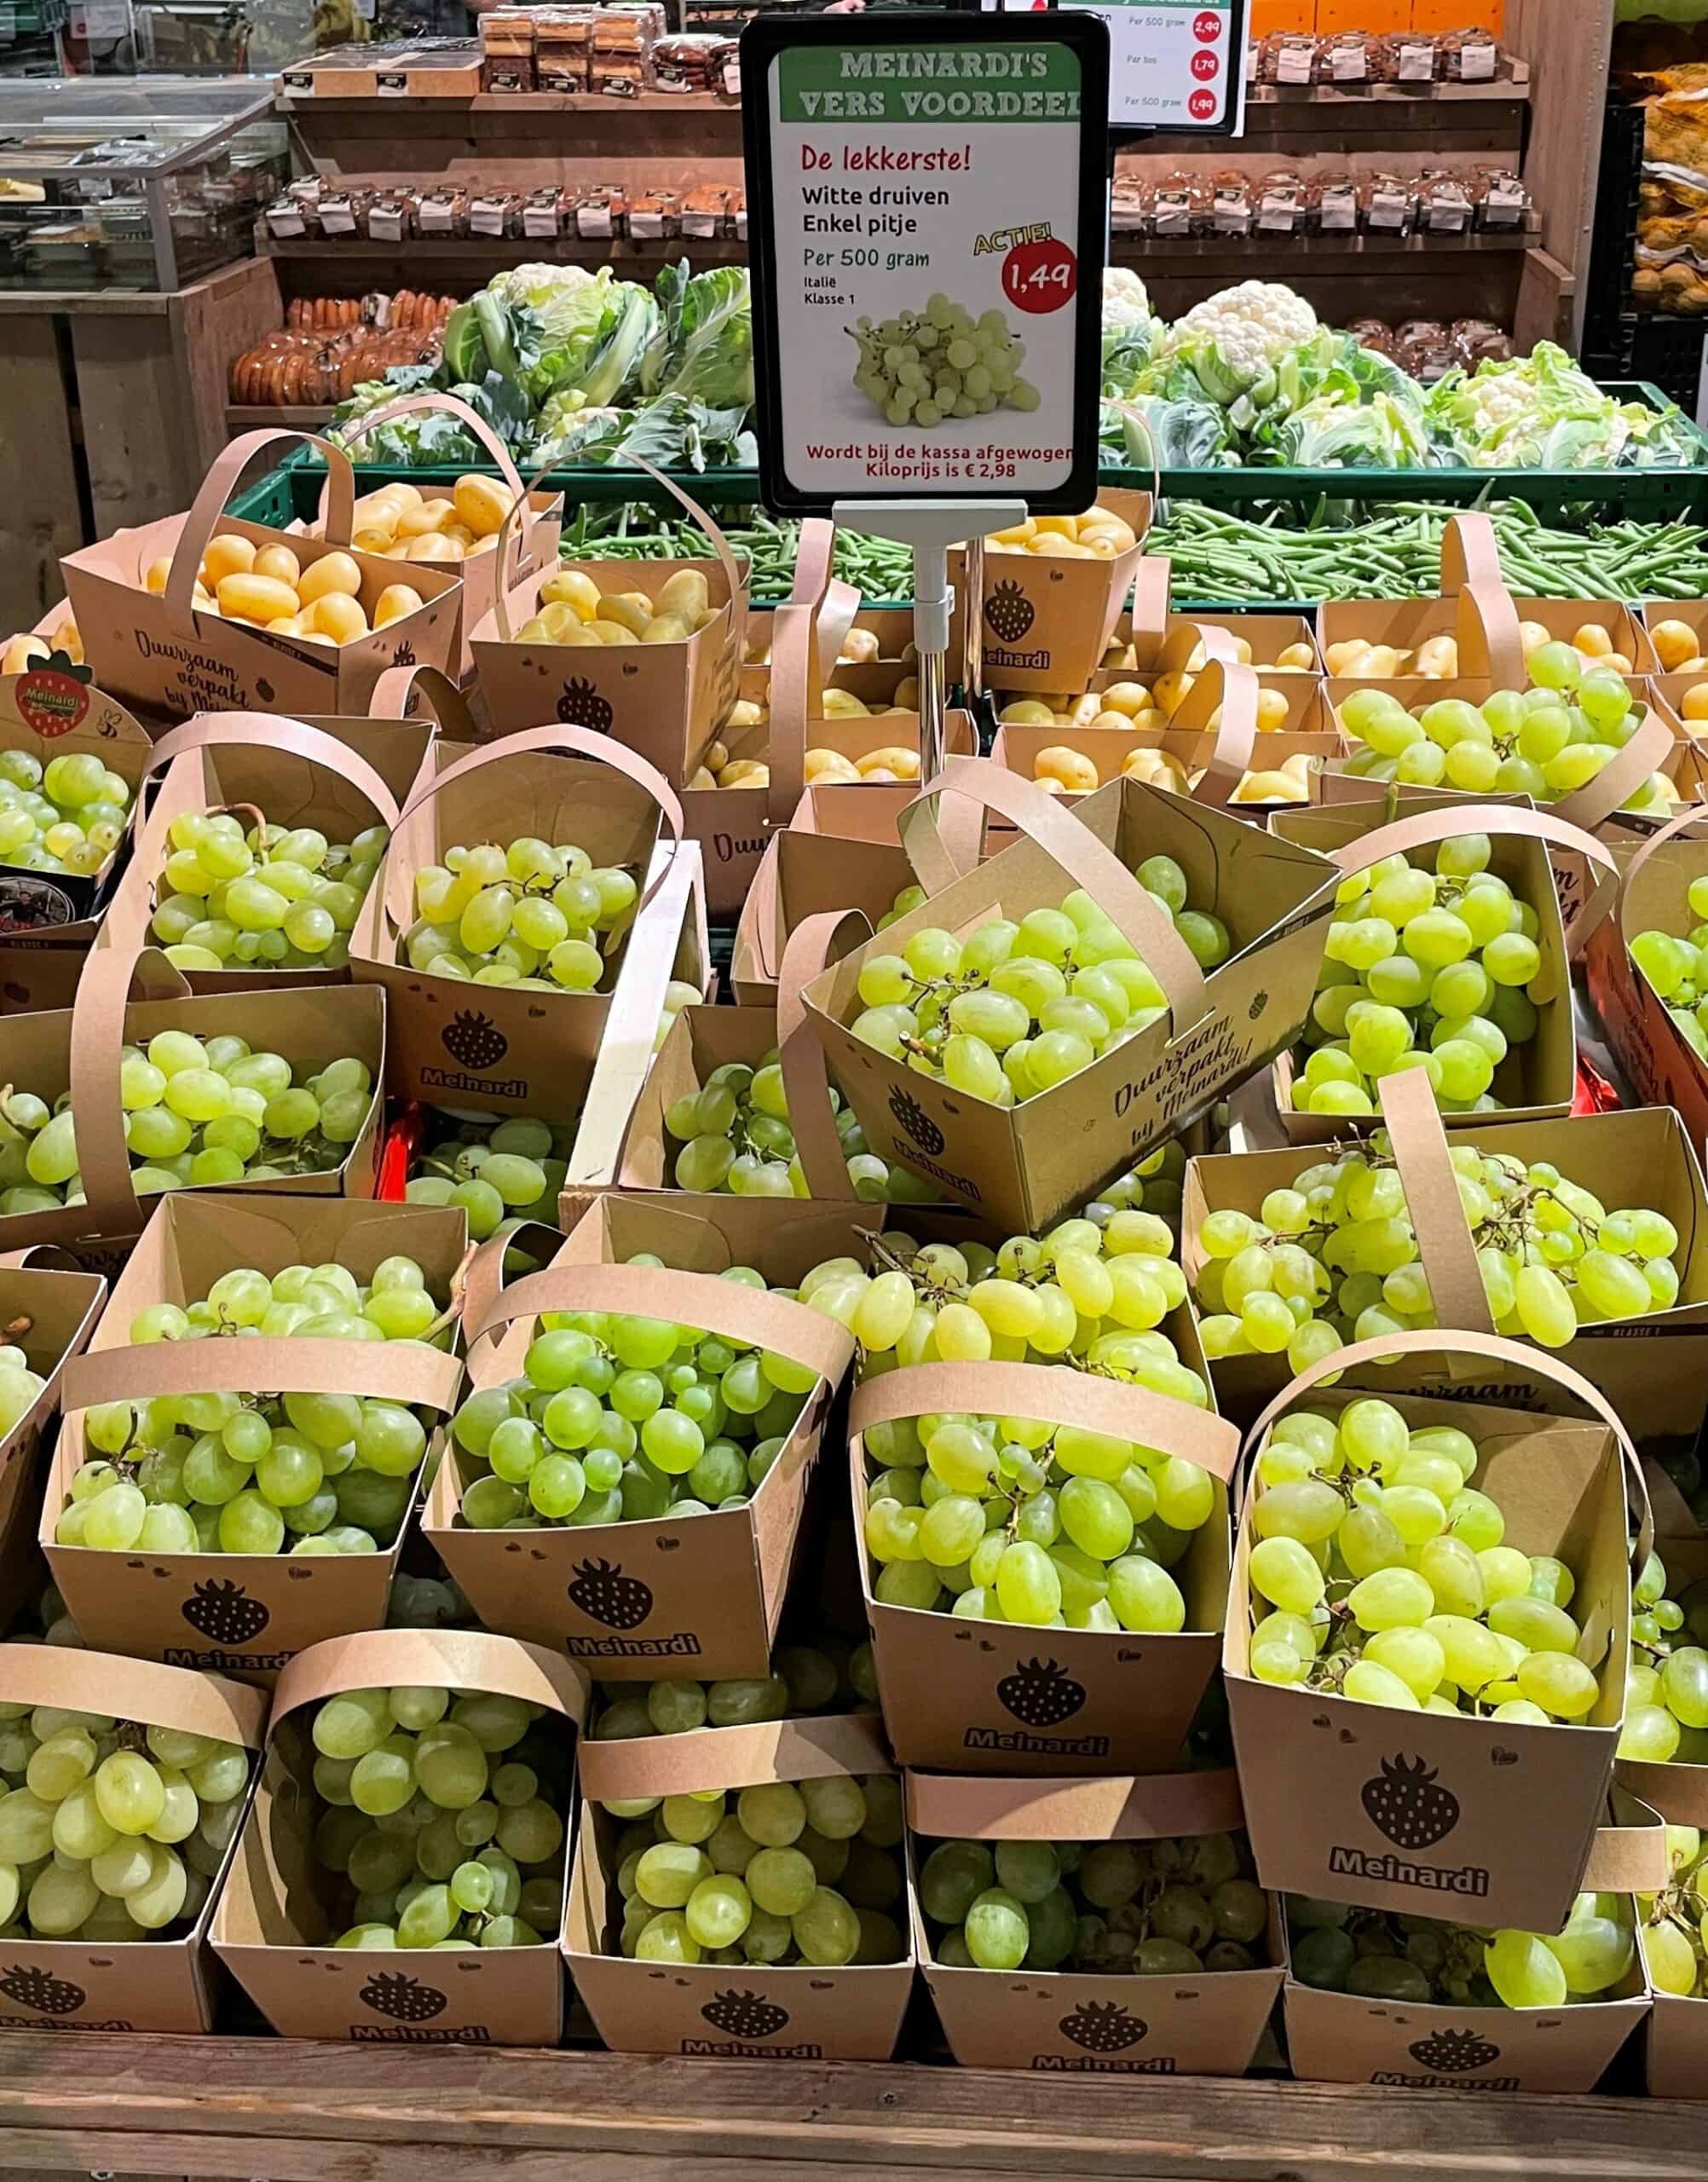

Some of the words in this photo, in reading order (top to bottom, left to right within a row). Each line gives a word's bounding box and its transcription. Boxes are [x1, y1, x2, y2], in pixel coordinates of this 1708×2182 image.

[1195, 21, 1220, 34] 2,99
[840, 52, 1047, 78] MEINARDI'S
[1194, 59, 1216, 72] 1,79
[799, 91, 885, 116] VERS
[1192, 99, 1214, 112] 1,99
[802, 144, 832, 170] De
[843, 144, 971, 170] lekkerste!
[802, 185, 863, 205] Witte
[869, 185, 949, 205] druiven
[803, 213, 862, 233] Enkel
[868, 213, 917, 236] pitje
[973, 222, 1052, 256] ACTIE!
[804, 248, 834, 266] Per
[840, 248, 879, 266] 500
[886, 253, 929, 270] gram
[804, 276, 836, 288] Italië
[1012, 263, 1070, 293] 1,49
[804, 293, 845, 305] Klasse
[849, 294, 856, 305] 1
[806, 446, 863, 459] Wordt
[868, 445, 889, 461] bij
[895, 445, 915, 459] de
[921, 445, 970, 459] kassa
[866, 465, 940, 479] Kiloprijs
[946, 464, 960, 477] is
[965, 465, 974, 477] €
[980, 465, 1016, 479] 2,98
[135, 629, 239, 683] Duurzaam
[176, 672, 251, 708] verpakt
[1115, 1015, 1235, 1118] Duurzaam
[1156, 1031, 1235, 1103] verpakt
[421, 1066, 528, 1099] Meinardi
[568, 1635, 701, 1658] Meinardi
[164, 1648, 295, 1670] Meinard
[965, 1728, 1110, 1757] Meinardi
[1330, 1847, 1489, 1897] Meinardi
[350, 2024, 491, 2041] Meinardi
[683, 2040, 822, 2059] Meinardi
[1033, 2055, 1175, 2074] Meinardi
